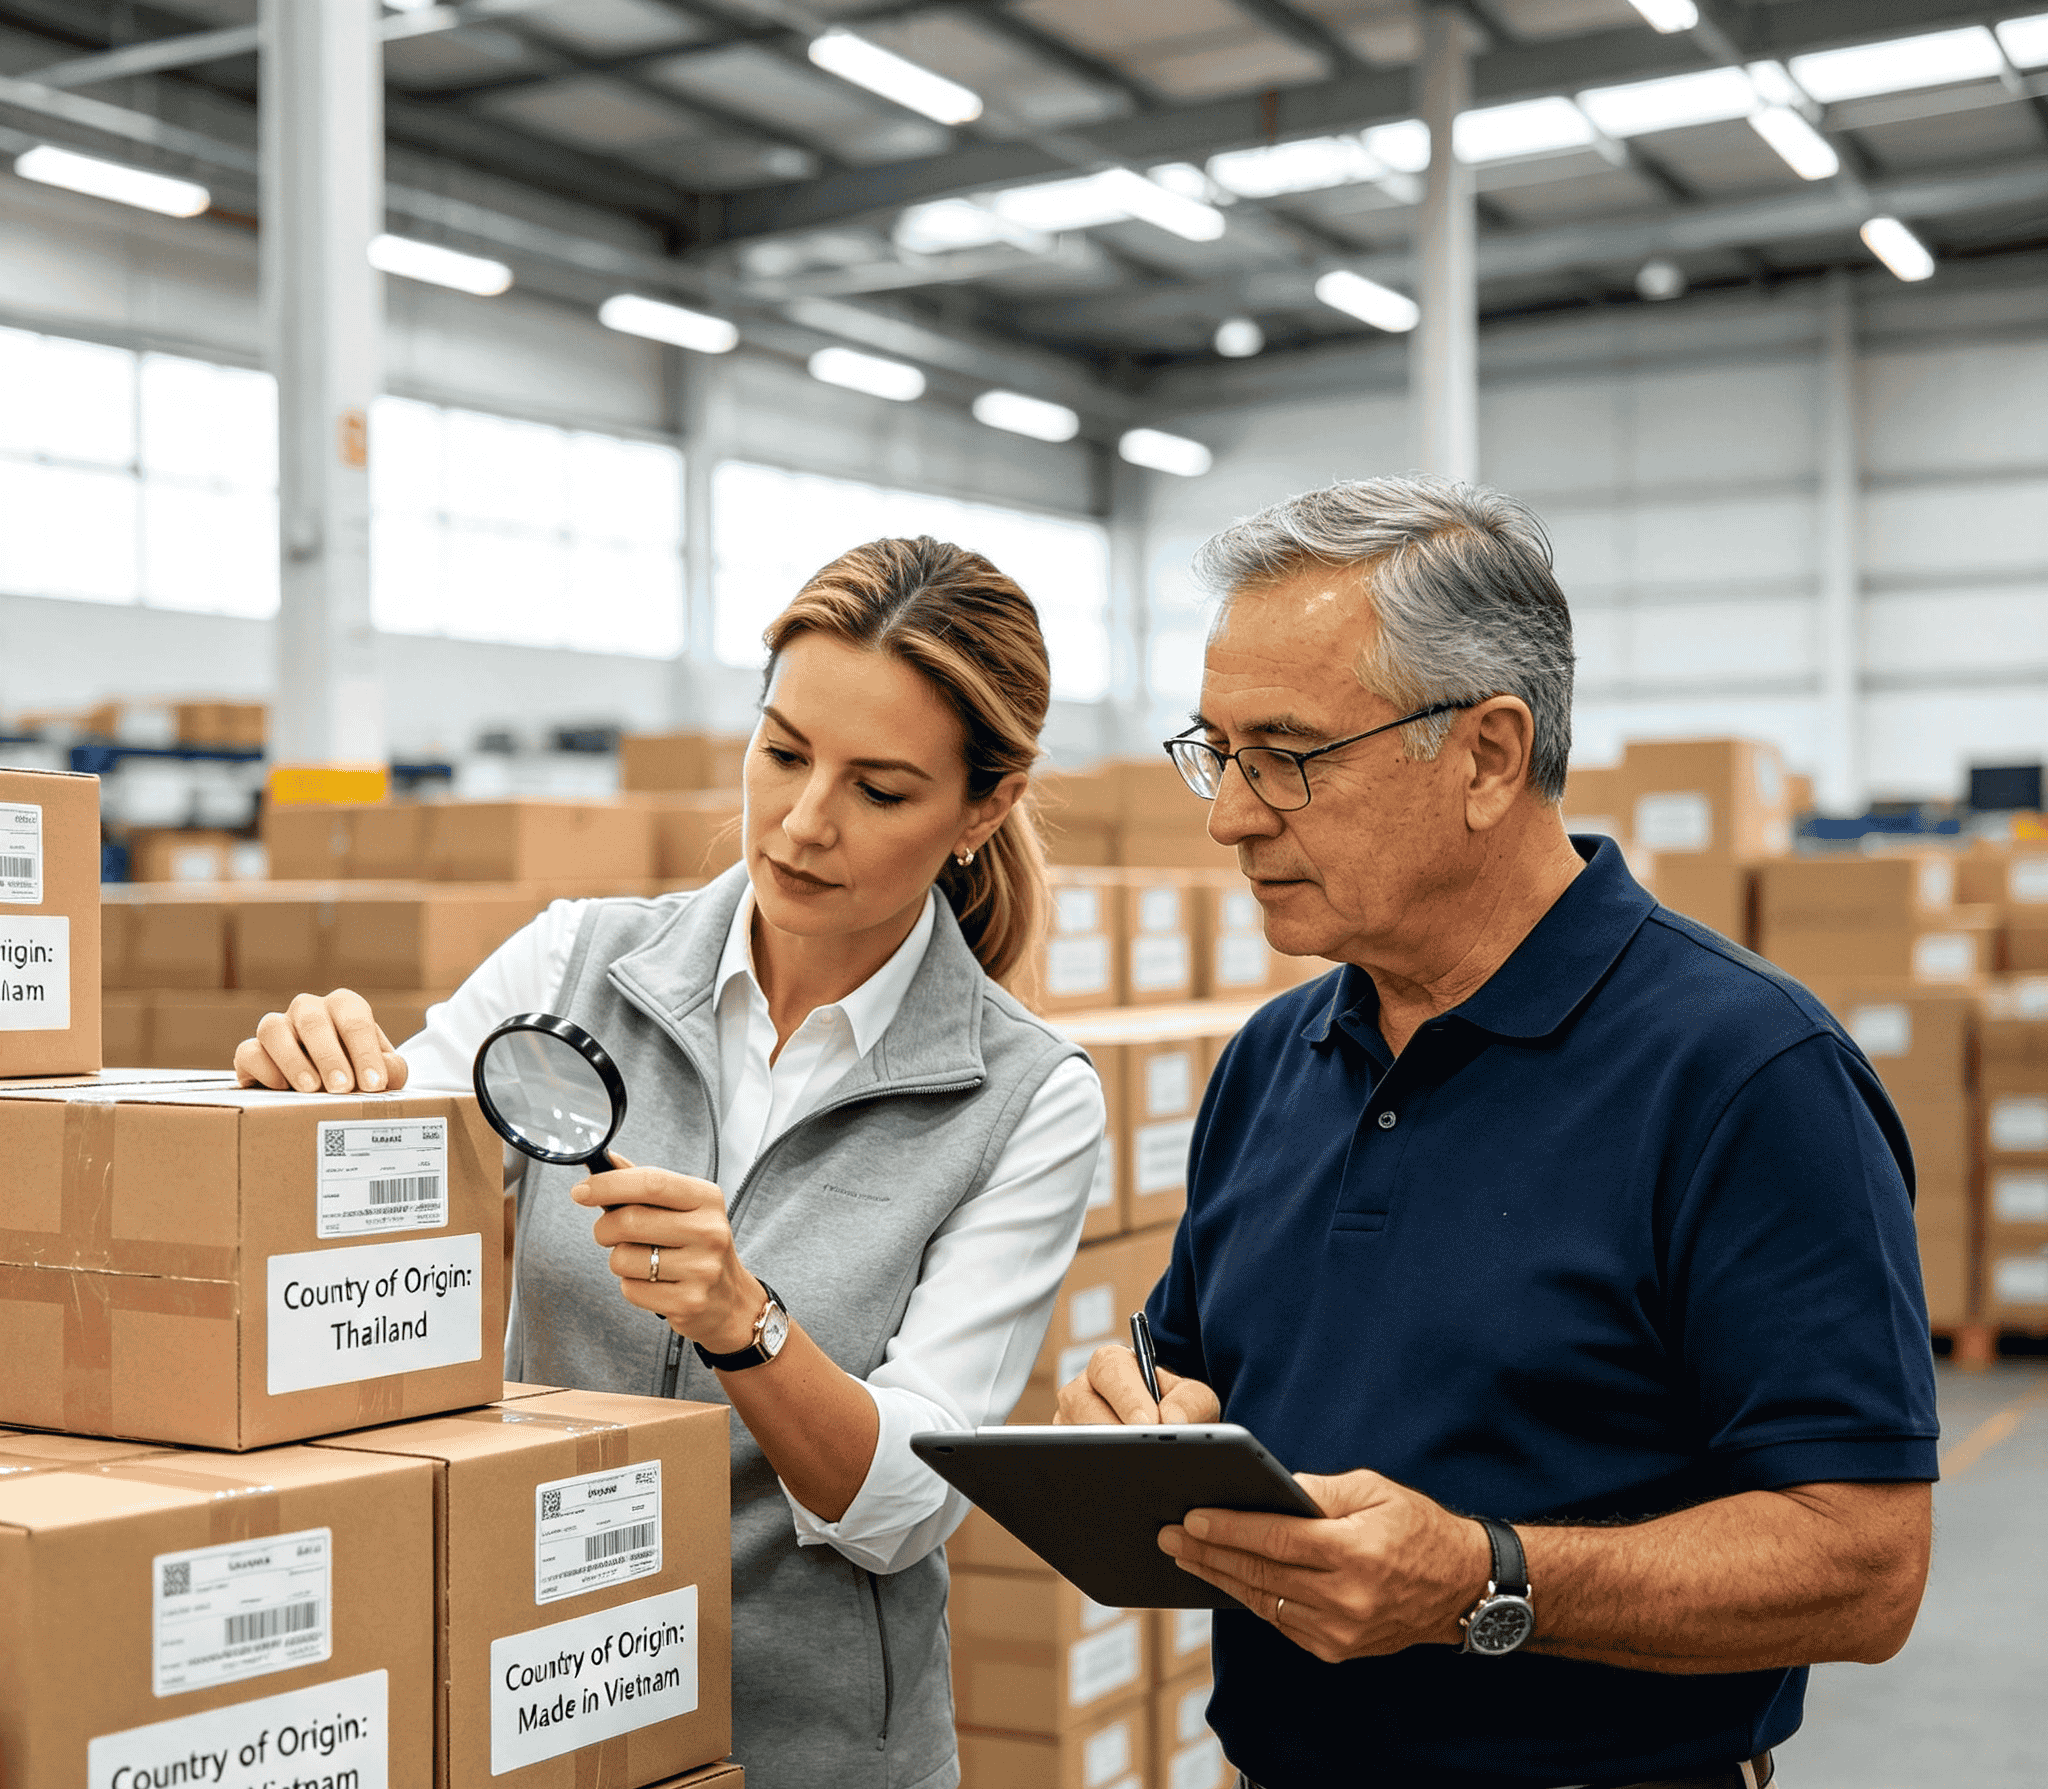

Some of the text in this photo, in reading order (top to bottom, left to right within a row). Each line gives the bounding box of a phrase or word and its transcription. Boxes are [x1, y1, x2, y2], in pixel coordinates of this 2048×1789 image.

[284, 1264, 471, 1309] Country of Origin:
[331, 1311, 426, 1350] Thailand
[505, 1622, 684, 1691] Country of Origin:
[519, 1668, 679, 1734] Made in Vietnam
[112, 1714, 366, 1789] Country of Origin:
